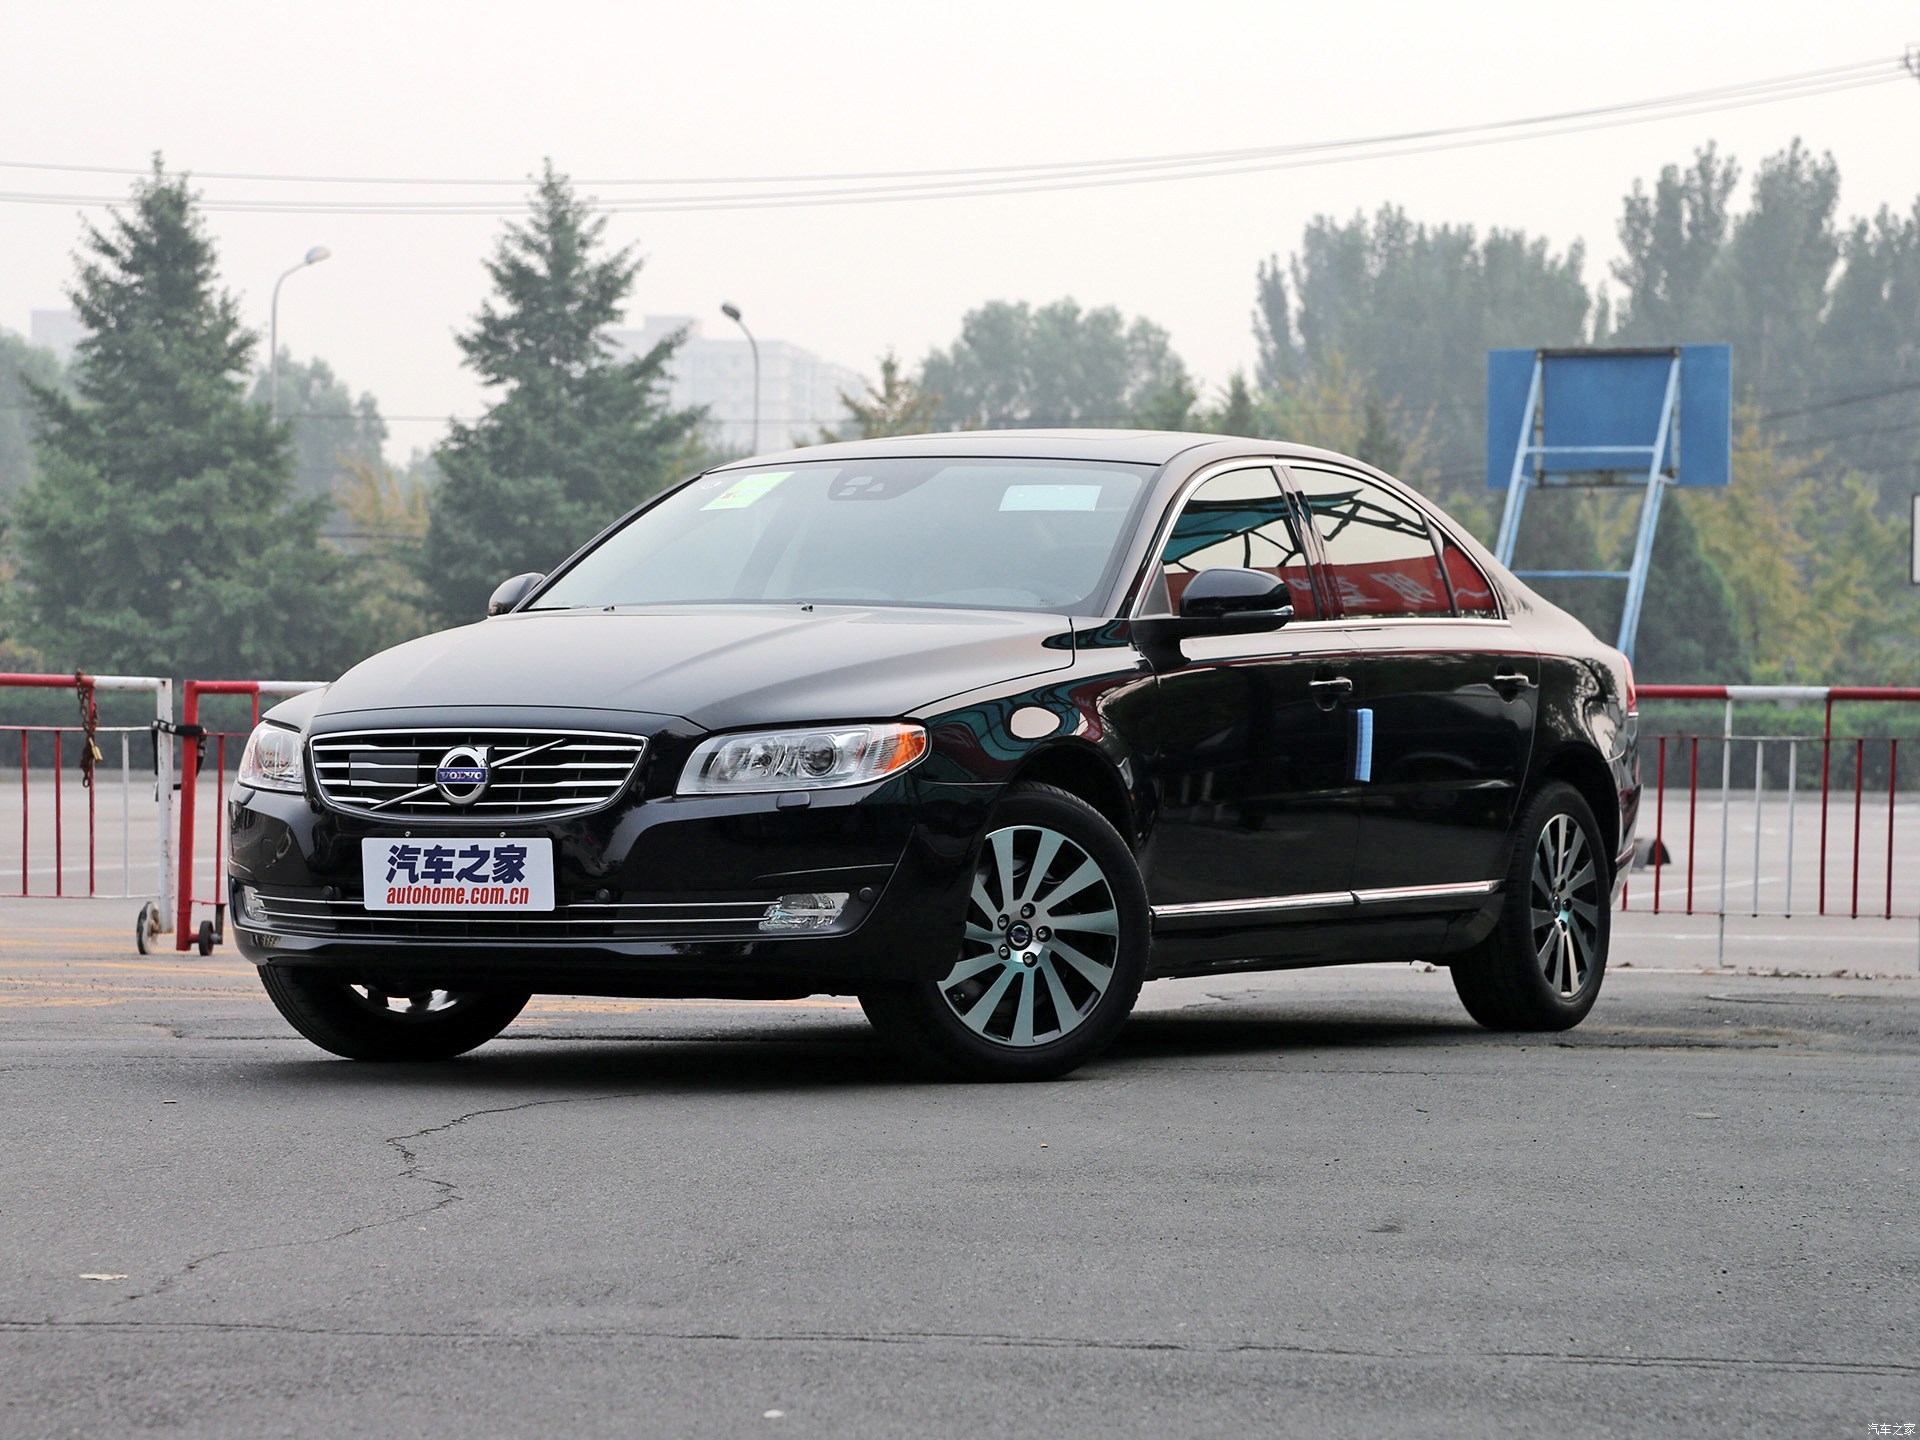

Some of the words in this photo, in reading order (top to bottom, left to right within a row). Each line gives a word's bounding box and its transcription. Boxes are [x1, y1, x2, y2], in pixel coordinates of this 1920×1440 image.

[438, 770, 484, 781] VOLVO
[385, 844, 528, 884] 汽车之家
[386, 885, 530, 905] autohome.com.cn
